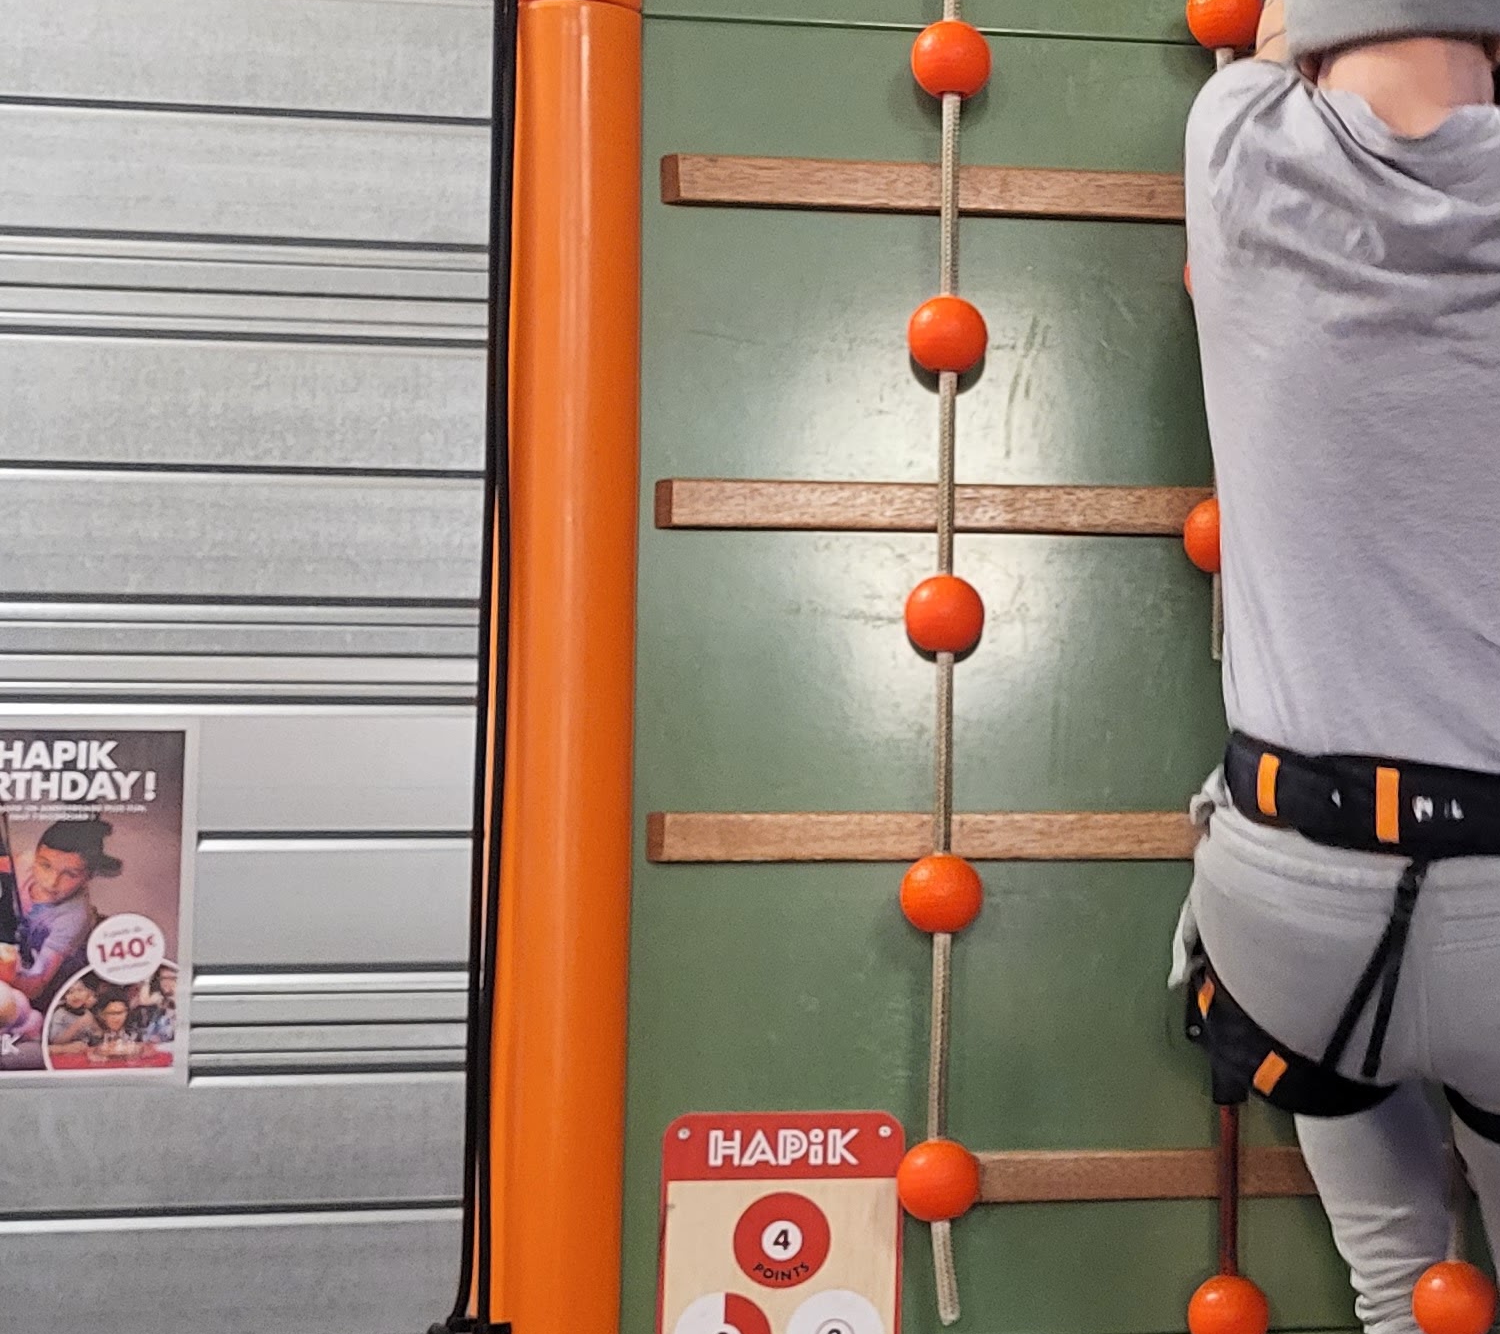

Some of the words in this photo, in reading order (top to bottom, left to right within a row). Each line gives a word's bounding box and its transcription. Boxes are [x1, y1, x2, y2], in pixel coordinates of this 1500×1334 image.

[0, 740, 118, 769] HAPIK
[772, 1229, 791, 1250] 4
[753, 1262, 810, 1281] POINTS
